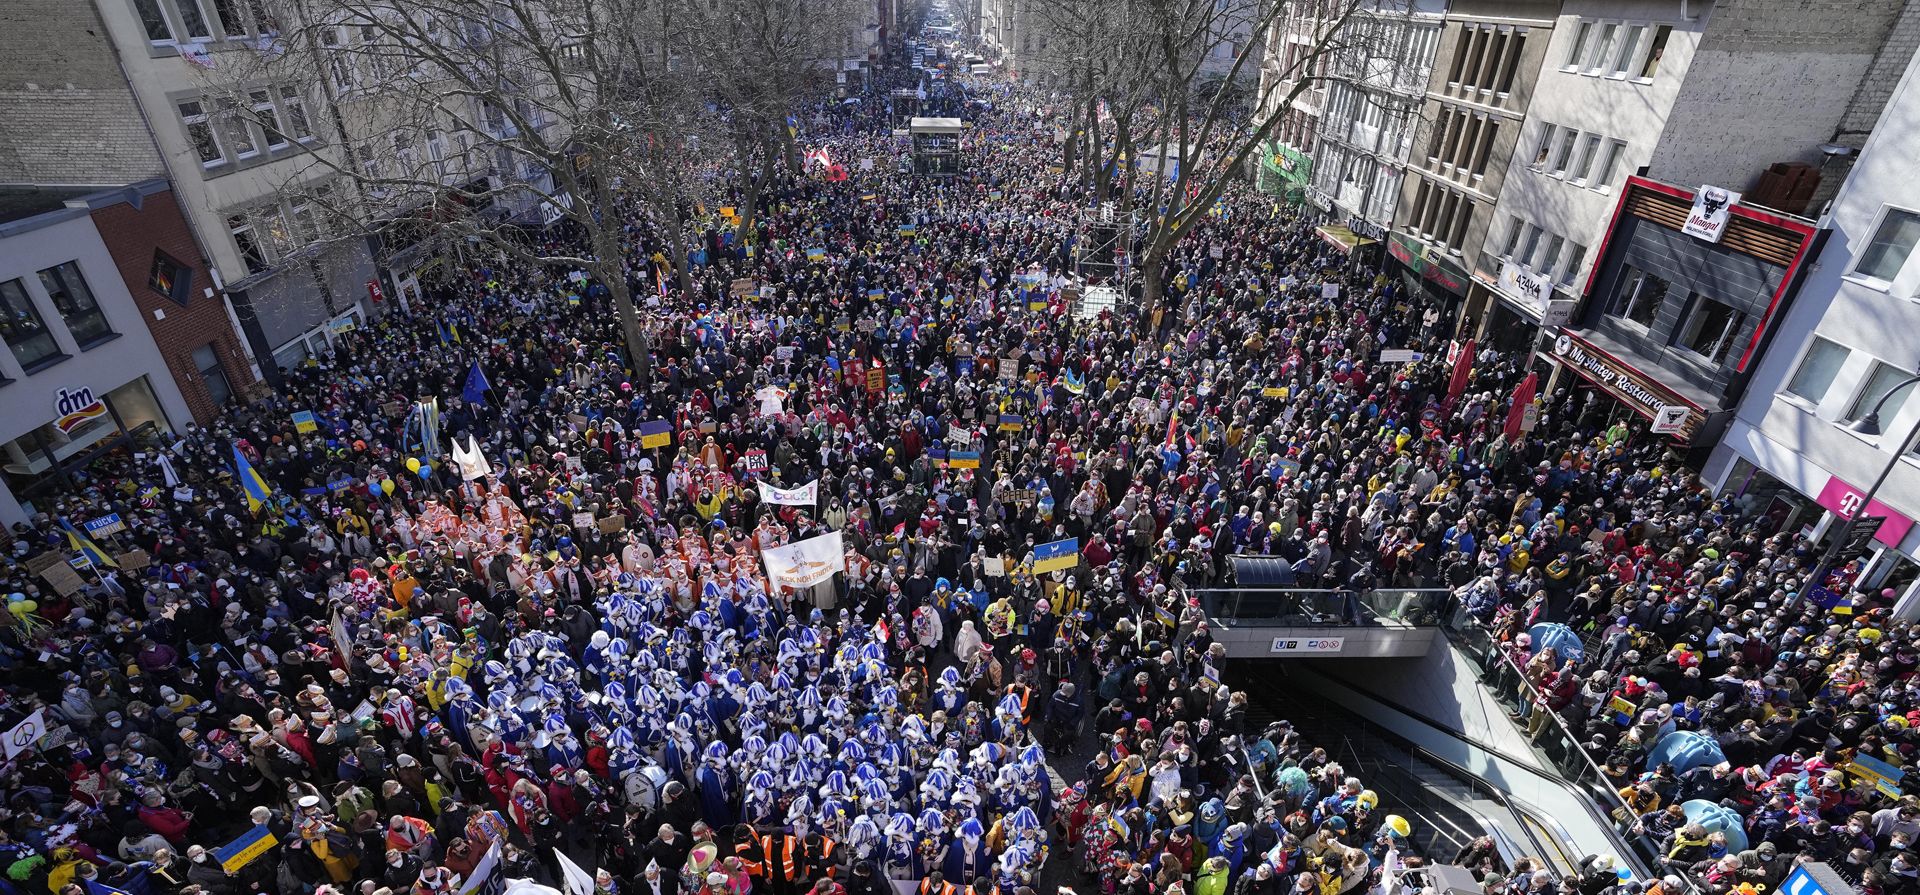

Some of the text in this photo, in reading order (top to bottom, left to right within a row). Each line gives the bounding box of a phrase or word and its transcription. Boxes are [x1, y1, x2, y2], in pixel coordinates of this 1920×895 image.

[932, 138, 940, 147] U
[1689, 215, 1720, 231] Mangal
[1569, 346, 1666, 412] My Antep Restaura
[59, 387, 95, 417] dm
[749, 455, 764, 464] FCK
[750, 460, 766, 470] PTN
[91, 515, 115, 529] FUCK
[96, 523, 122, 538] PUTIN
